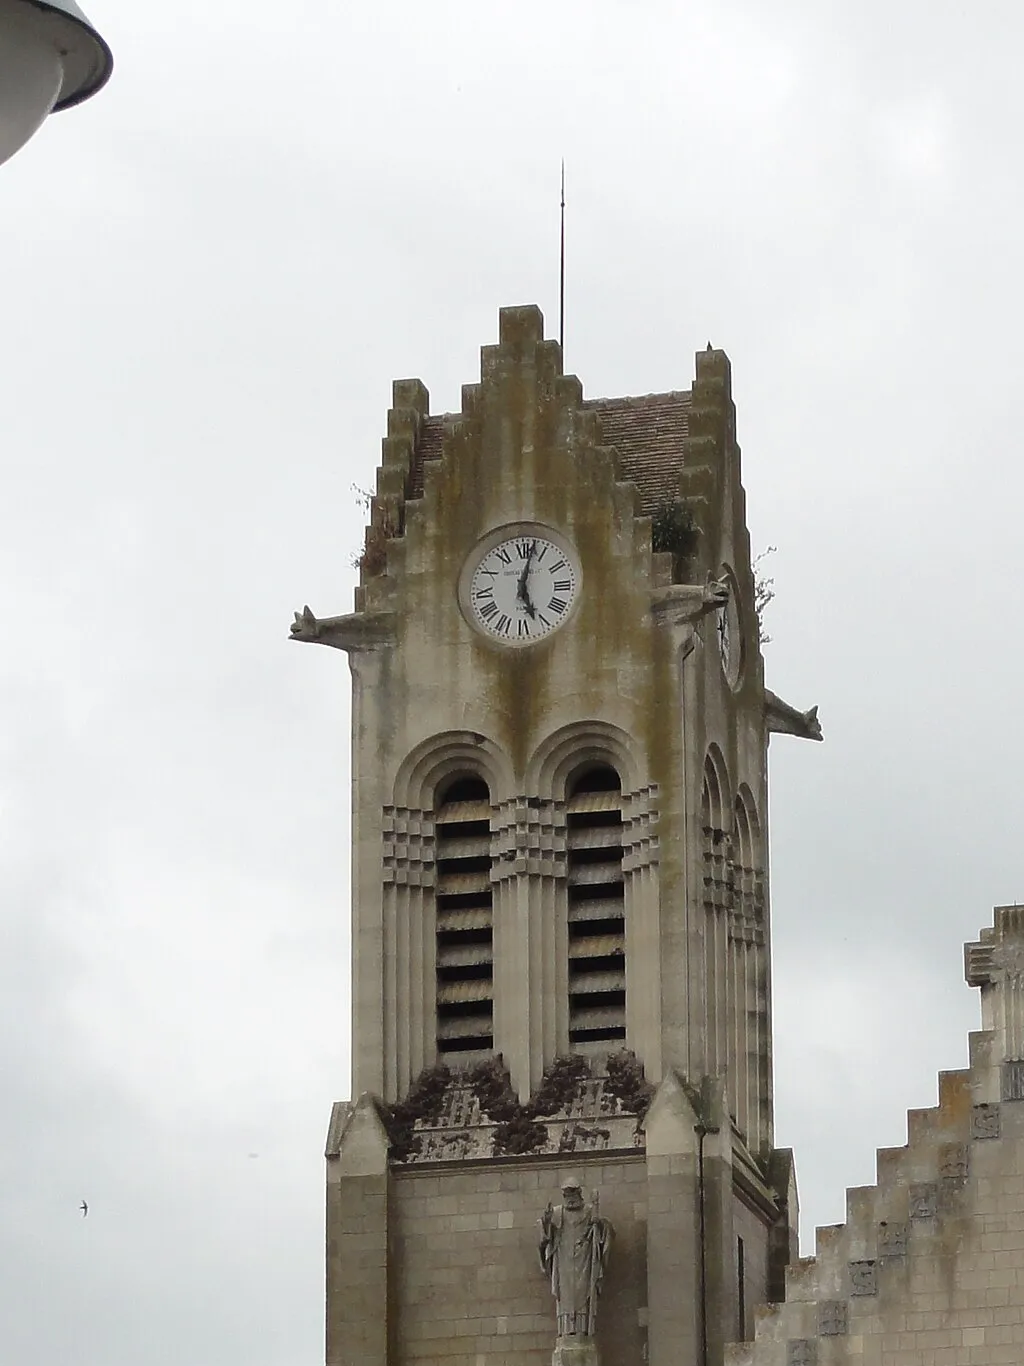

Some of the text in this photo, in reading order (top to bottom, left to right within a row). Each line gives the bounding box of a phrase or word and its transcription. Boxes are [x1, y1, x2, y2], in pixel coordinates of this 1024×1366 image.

[496, 549, 513, 568] XI
[538, 546, 548, 562] I
[481, 564, 499, 582] X
[548, 560, 566, 575] II
[476, 586, 494, 599] IX
[553, 579, 571, 592] III
[547, 596, 568, 615] IIII
[518, 618, 530, 636] VI
